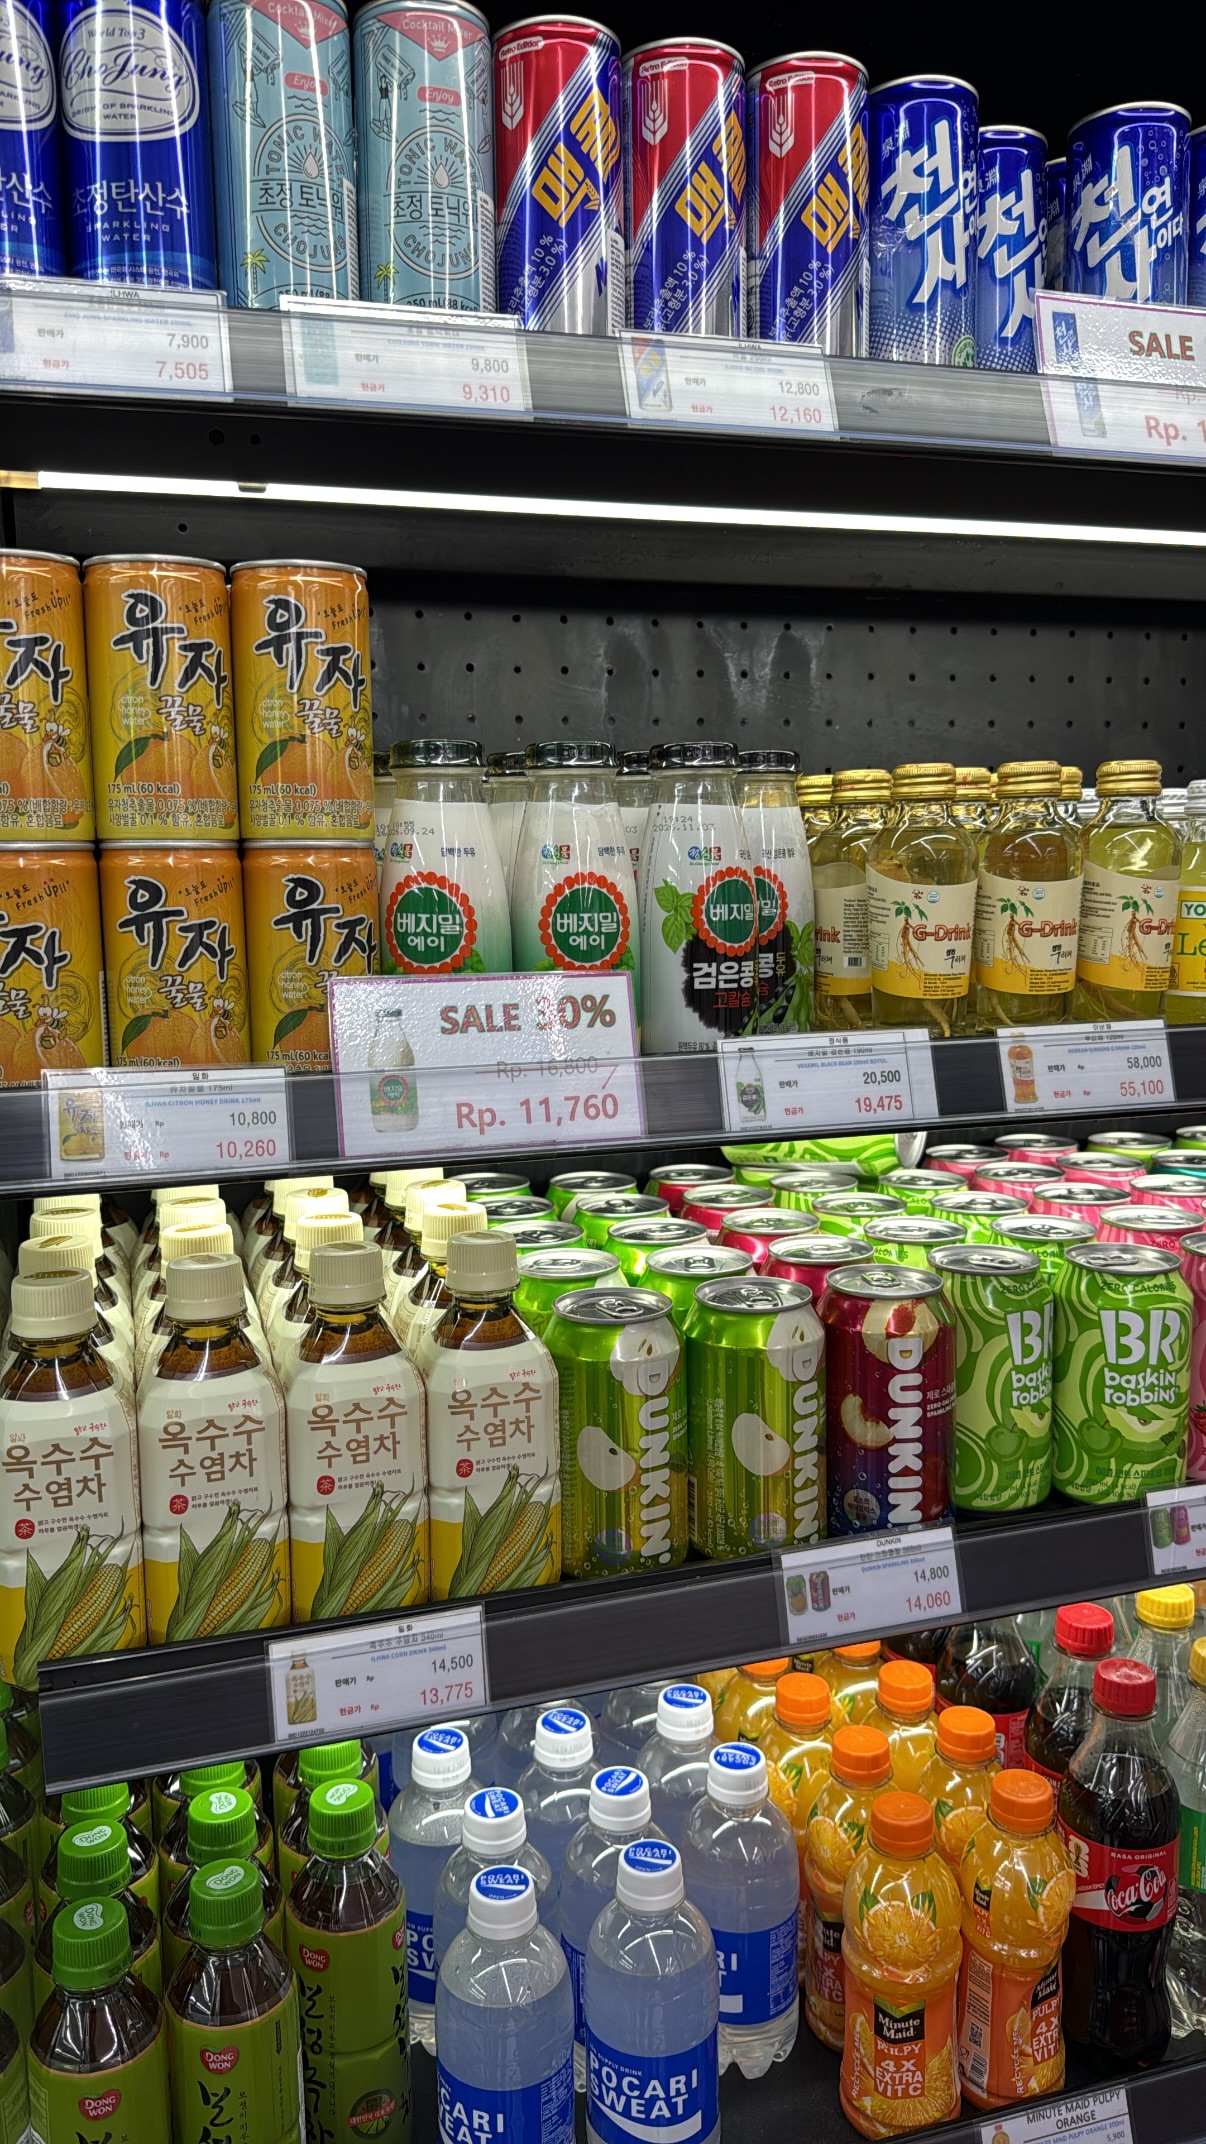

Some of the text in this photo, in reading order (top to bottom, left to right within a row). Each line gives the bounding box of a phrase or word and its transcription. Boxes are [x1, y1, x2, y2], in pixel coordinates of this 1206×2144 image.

[402, 19, 444, 33] Cocktail
[424, 88, 455, 104] Enjoy
[103, 113, 137, 121] WATER
[265, 125, 305, 175] TONIC
[398, 137, 436, 189] TONIC
[72, 179, 191, 220] 초정탄산수
[258, 182, 294, 209] 초정
[86, 220, 170, 233] SPARKLING
[101, 234, 151, 242] WATER
[166, 332, 209, 350] 7,900
[1128, 330, 1195, 361] SALE
[155, 360, 209, 381] 7,505
[471, 358, 509, 374] 9,800
[462, 384, 511, 403] 9,310
[778, 381, 819, 397] 12,800
[769, 404, 822, 425] 12,160
[1144, 415, 1187, 446] Rp.
[111, 588, 228, 708] 유자
[253, 594, 366, 711] 유자
[121, 717, 147, 727] water
[159, 695, 205, 736] 꿀물
[261, 720, 286, 730] water
[296, 698, 342, 738] 꿀물
[107, 783, 121, 794] 175
[156, 782, 180, 796] kcal)
[249, 784, 261, 795] 175
[294, 783, 318, 797] kcal)
[117, 874, 237, 982] 유자
[271, 874, 378, 976] 유자
[397, 913, 461, 935] 베지밀
[556, 912, 618, 934] 베지밀
[912, 922, 971, 942] G-Drink
[1018, 918, 1077, 938] G-Drink
[407, 935, 445, 952] 에이
[569, 935, 605, 951] 에이
[158, 974, 209, 1011] 꿀물
[440, 1003, 522, 1036] SALE
[266, 1050, 280, 1061] 175
[1126, 1055, 1162, 1070] 58,000
[497, 1060, 527, 1083] Rp.
[778, 1069, 901, 1089] 판매가 20,500
[1119, 1079, 1164, 1098] 55,100
[456, 1093, 619, 1136] Rp. 11,760
[784, 1094, 903, 1116] 현금가 19,475
[229, 1110, 277, 1129] 10,800
[215, 1138, 277, 1160] 10,260
[1150, 1239, 1176, 1250] ZERO
[1000, 1282, 1025, 1294] ZERO
[1100, 1281, 1126, 1294] ZERO
[1099, 1309, 1181, 1366] BR
[447, 1381, 542, 1422] 옥수수
[926, 1388, 939, 1400] 제로
[926, 1401, 941, 1411] ZERO
[307, 1396, 408, 1437] 옥수수
[158, 1415, 266, 1455] 옥수수
[456, 1415, 535, 1452] 수염차
[887, 1337, 923, 1524] DUNKIN
[316, 1431, 401, 1469] 수염차
[792, 1348, 819, 1539] DUNKIN
[1, 1437, 114, 1480] 옥수수
[169, 1448, 258, 1488] 수염차
[458, 1461, 471, 1475] 茶
[637, 1360, 671, 1557] DUNKIN
[13, 1473, 107, 1512] 수염차
[319, 1478, 334, 1492] 茶
[171, 1497, 188, 1513] 茶
[17, 1521, 34, 1537] 茶
[876, 1537, 902, 1547] DUNKIN
[913, 1565, 949, 1583] 14,800
[905, 1590, 951, 1613] 14,060
[334, 1676, 357, 1687] 판매가
[431, 1654, 474, 1674] 14,500
[339, 1704, 362, 1716] 현금가
[420, 1681, 474, 1706] 13,775
[1134, 1850, 1167, 1861] ORIGINAL
[1106, 1865, 1167, 1912] Coca-Cola
[302, 1949, 326, 1963] DONG
[305, 1958, 324, 1969] WON
[878, 2012, 921, 2029] Minute
[882, 2025, 917, 2040] Maid
[205, 2051, 234, 2062] DONG
[208, 2061, 231, 2070] WON
[589, 2051, 698, 2099] POCARI
[620, 2066, 643, 2077] DRINK
[875, 2066, 923, 2084] EXTRA
[590, 2077, 688, 2120] SWEAT
[876, 2079, 923, 2098] VIT C
[84, 2095, 116, 2110] DONG
[88, 2105, 113, 2117] WON
[1027, 2089, 1121, 2125] MINUTE MAID PULPY
[1055, 2110, 1097, 2130] ORANGE
[1106, 2130, 1125, 2142] 5,900
